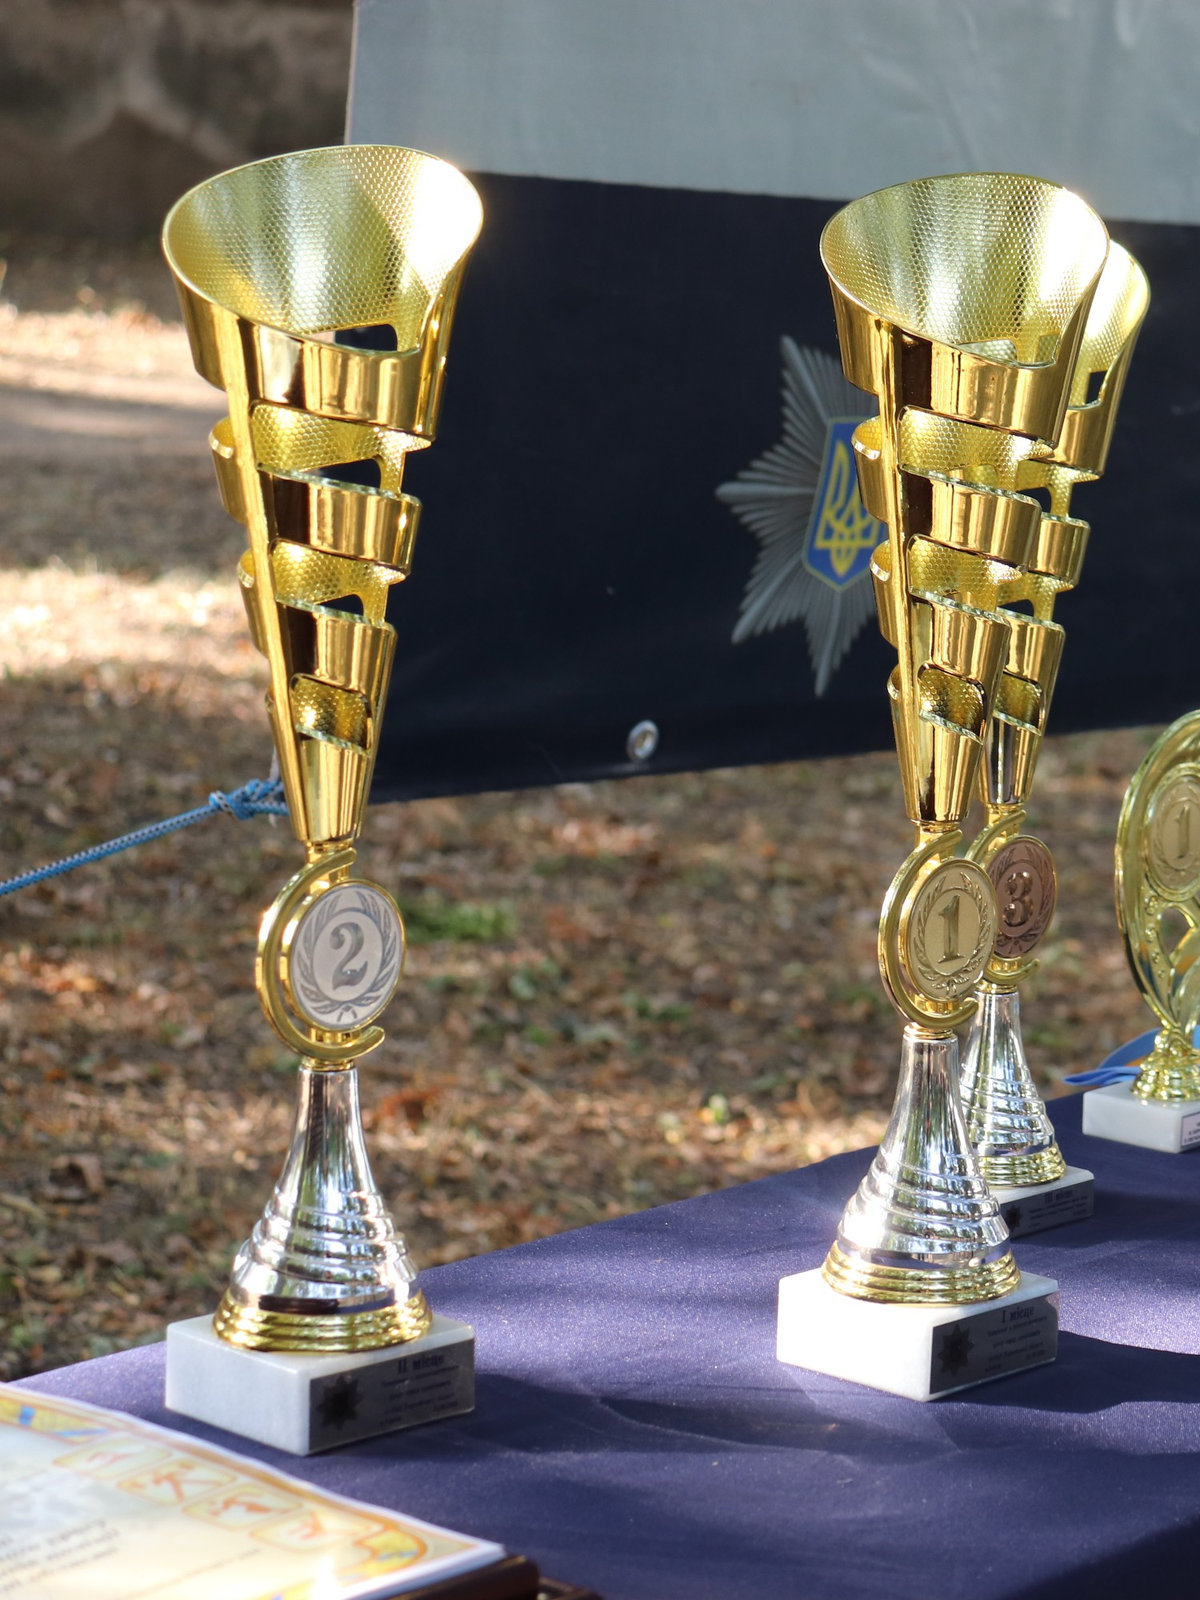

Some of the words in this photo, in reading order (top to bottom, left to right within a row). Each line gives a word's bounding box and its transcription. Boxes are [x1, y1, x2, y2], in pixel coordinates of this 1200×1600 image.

[1174, 804, 1191, 859] 1
[937, 894, 965, 964] 1
[1003, 871, 1034, 928] 3
[329, 922, 369, 991] 2
